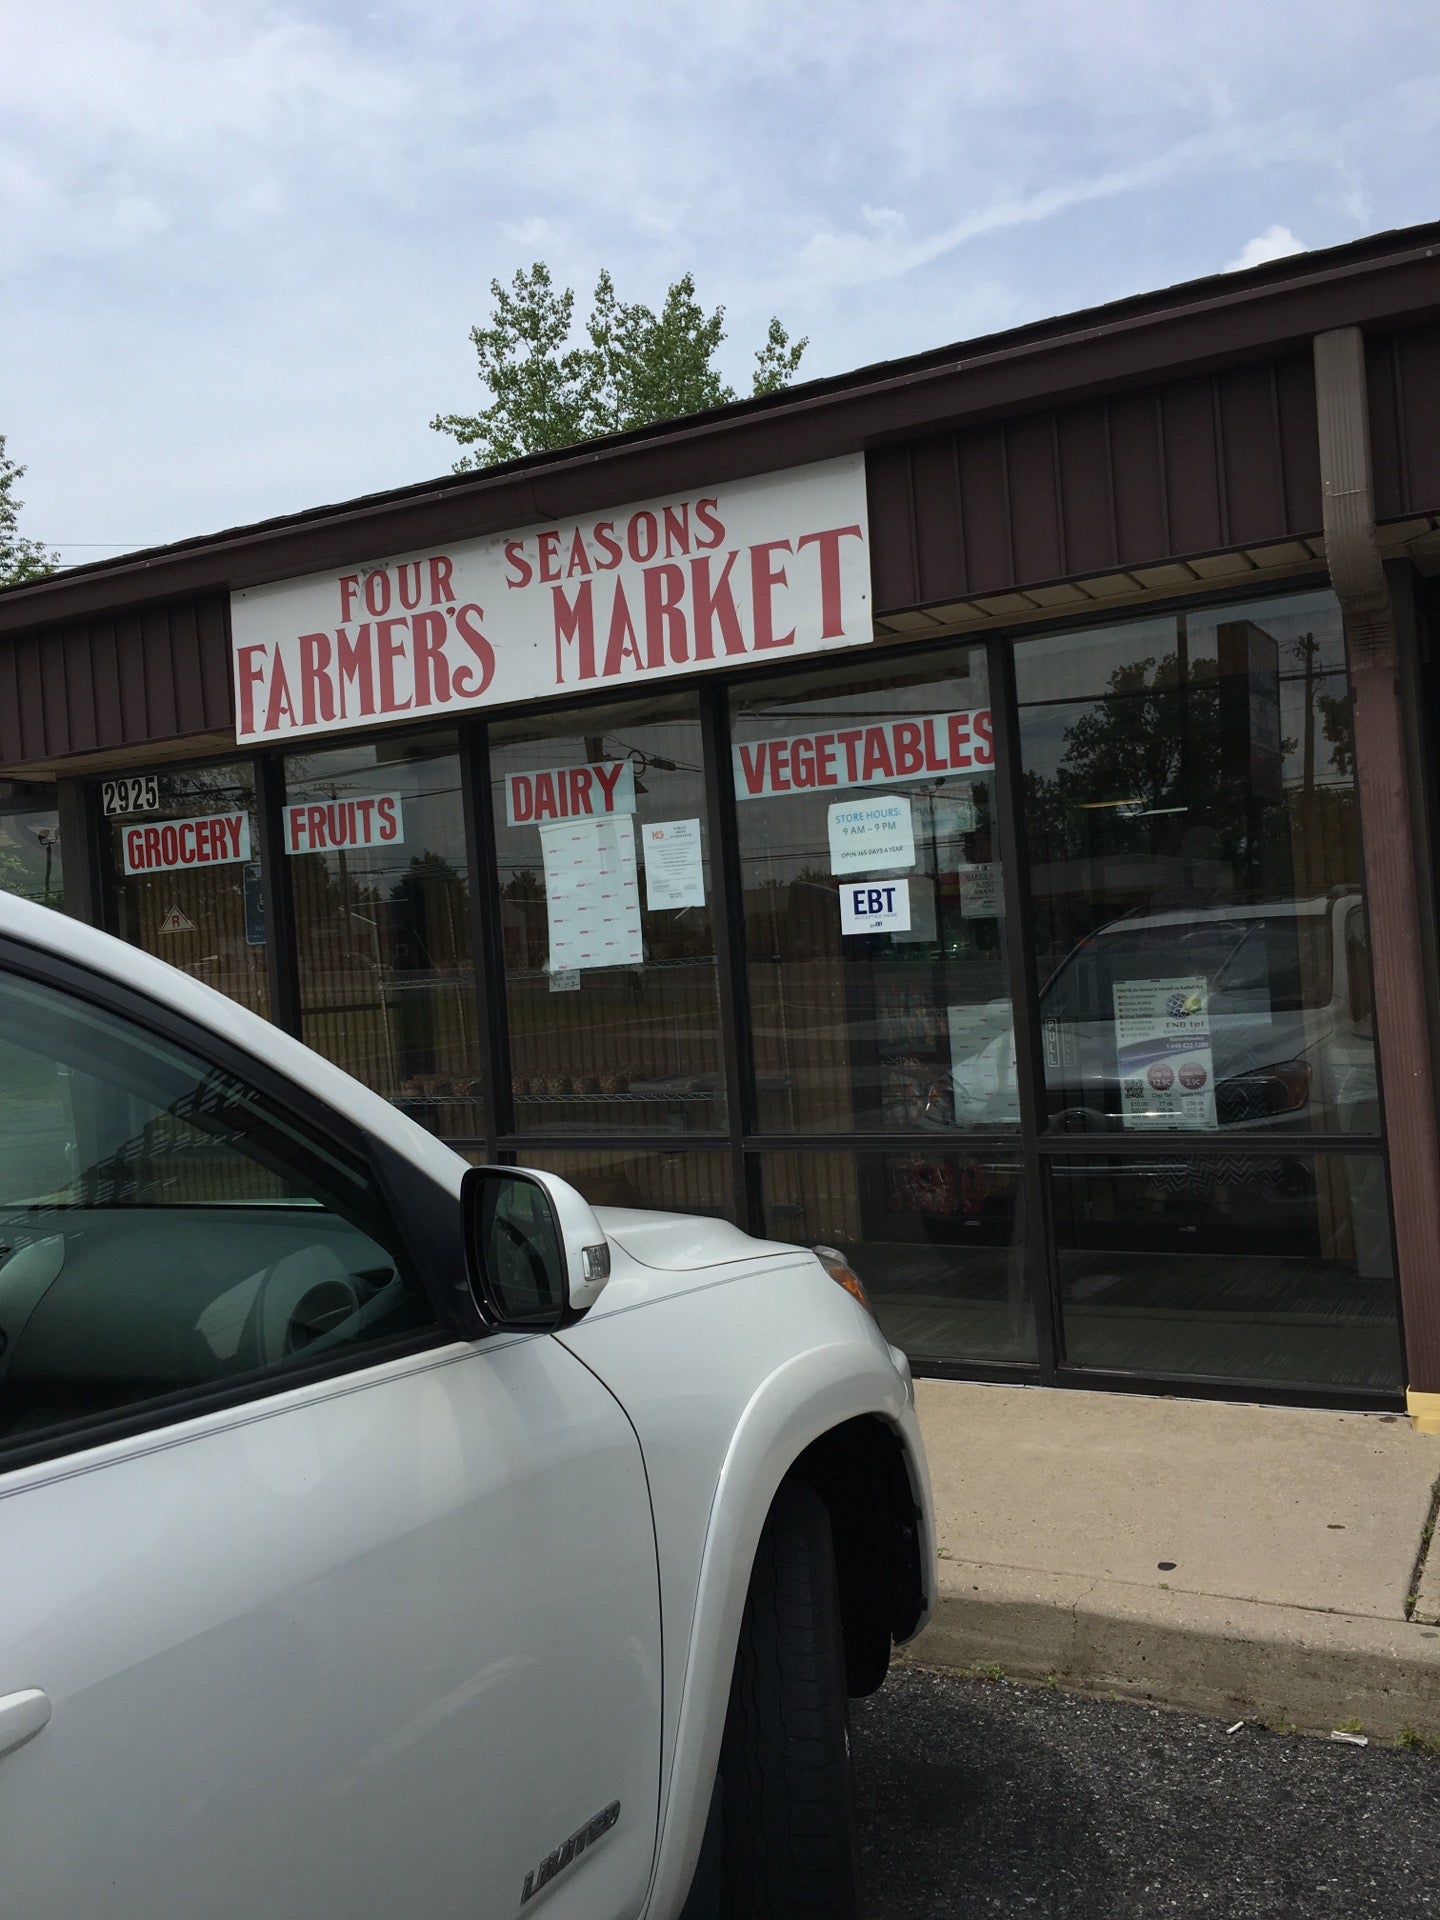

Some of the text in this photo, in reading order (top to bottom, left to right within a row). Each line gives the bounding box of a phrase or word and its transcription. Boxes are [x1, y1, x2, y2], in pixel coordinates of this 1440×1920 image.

[340, 498, 727, 624] FOUR SEASONS
[236, 524, 863, 736] FARMER'S MARKET
[739, 710, 995, 795] VEGETABLES
[104, 777, 158, 815] 2925
[511, 762, 624, 822] DAIRY
[290, 797, 398, 851] FRUITS
[835, 811, 864, 824] STORE
[842, 827, 849, 837] 9
[850, 825, 866, 836] AM
[874, 822, 880, 832] 9
[882, 821, 897, 831] PM
[127, 815, 243, 870] GROCERY
[171, 914, 180, 928] R
[853, 887, 896, 916] EBT
[1047, 1019, 1057, 1064] PULL
